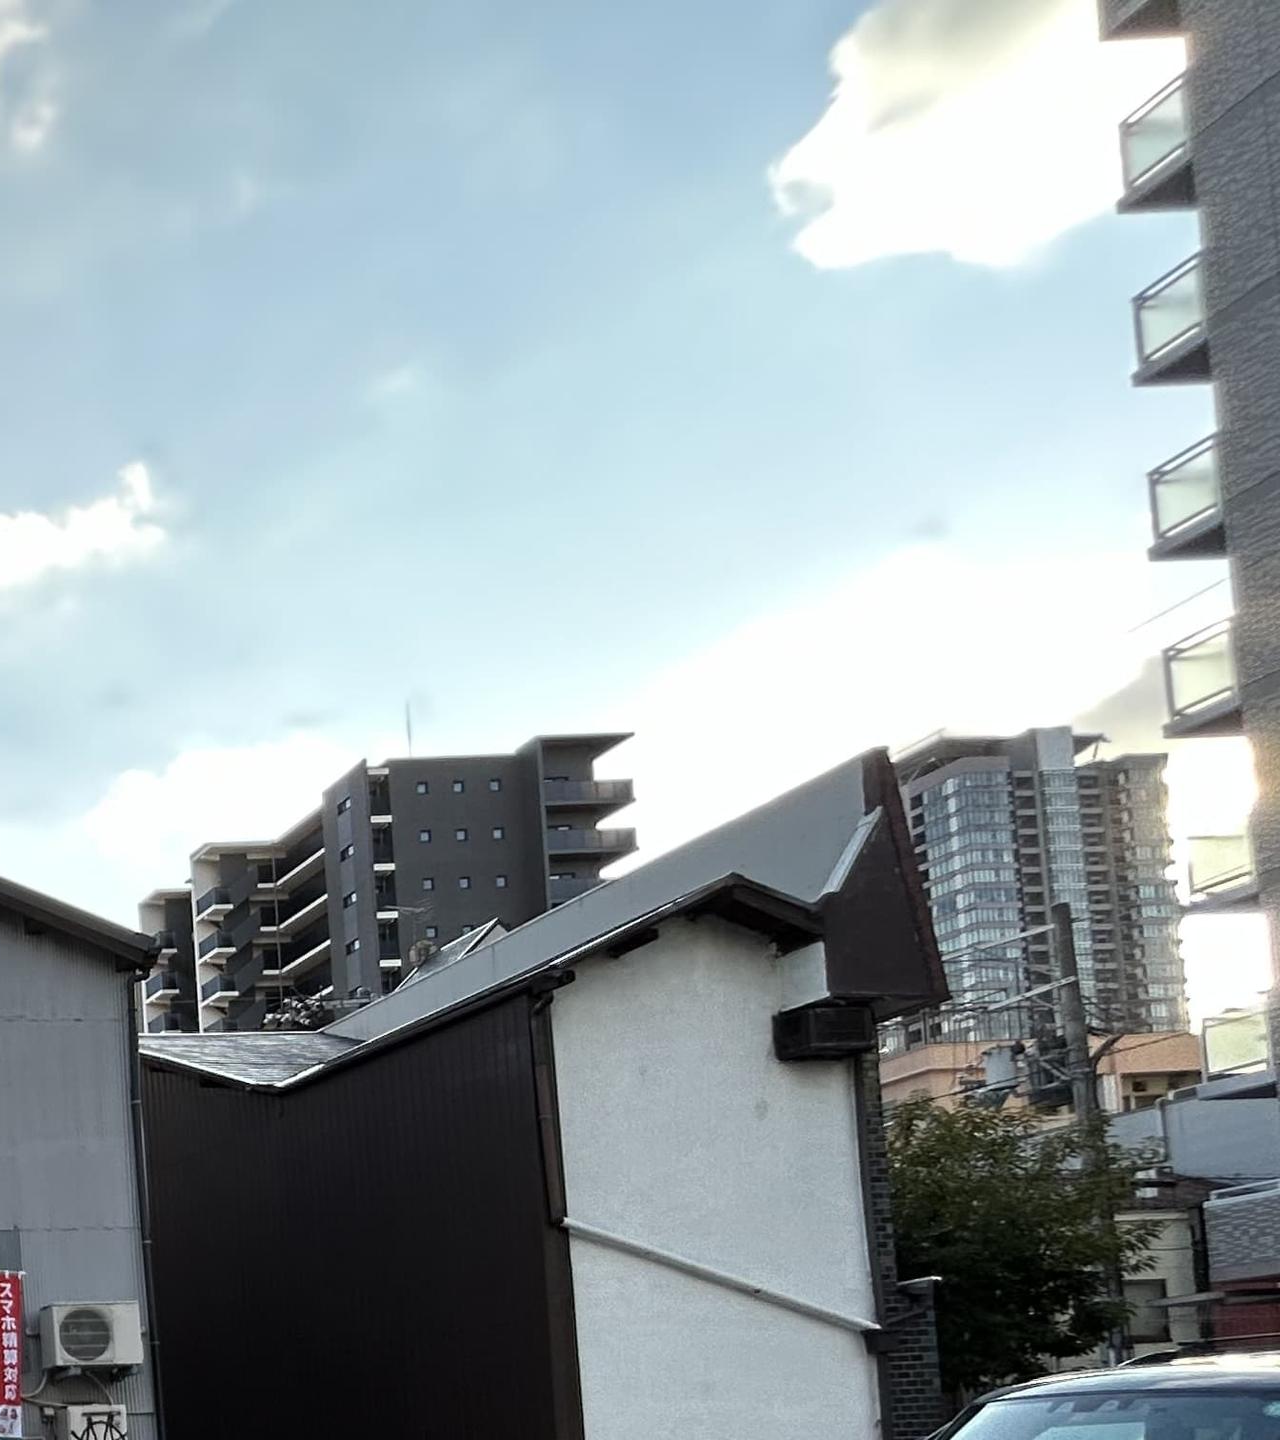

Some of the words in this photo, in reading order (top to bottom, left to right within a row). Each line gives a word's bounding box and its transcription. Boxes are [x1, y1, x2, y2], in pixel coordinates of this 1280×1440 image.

[0, 1282, 18, 1400] スマホ精算対応
